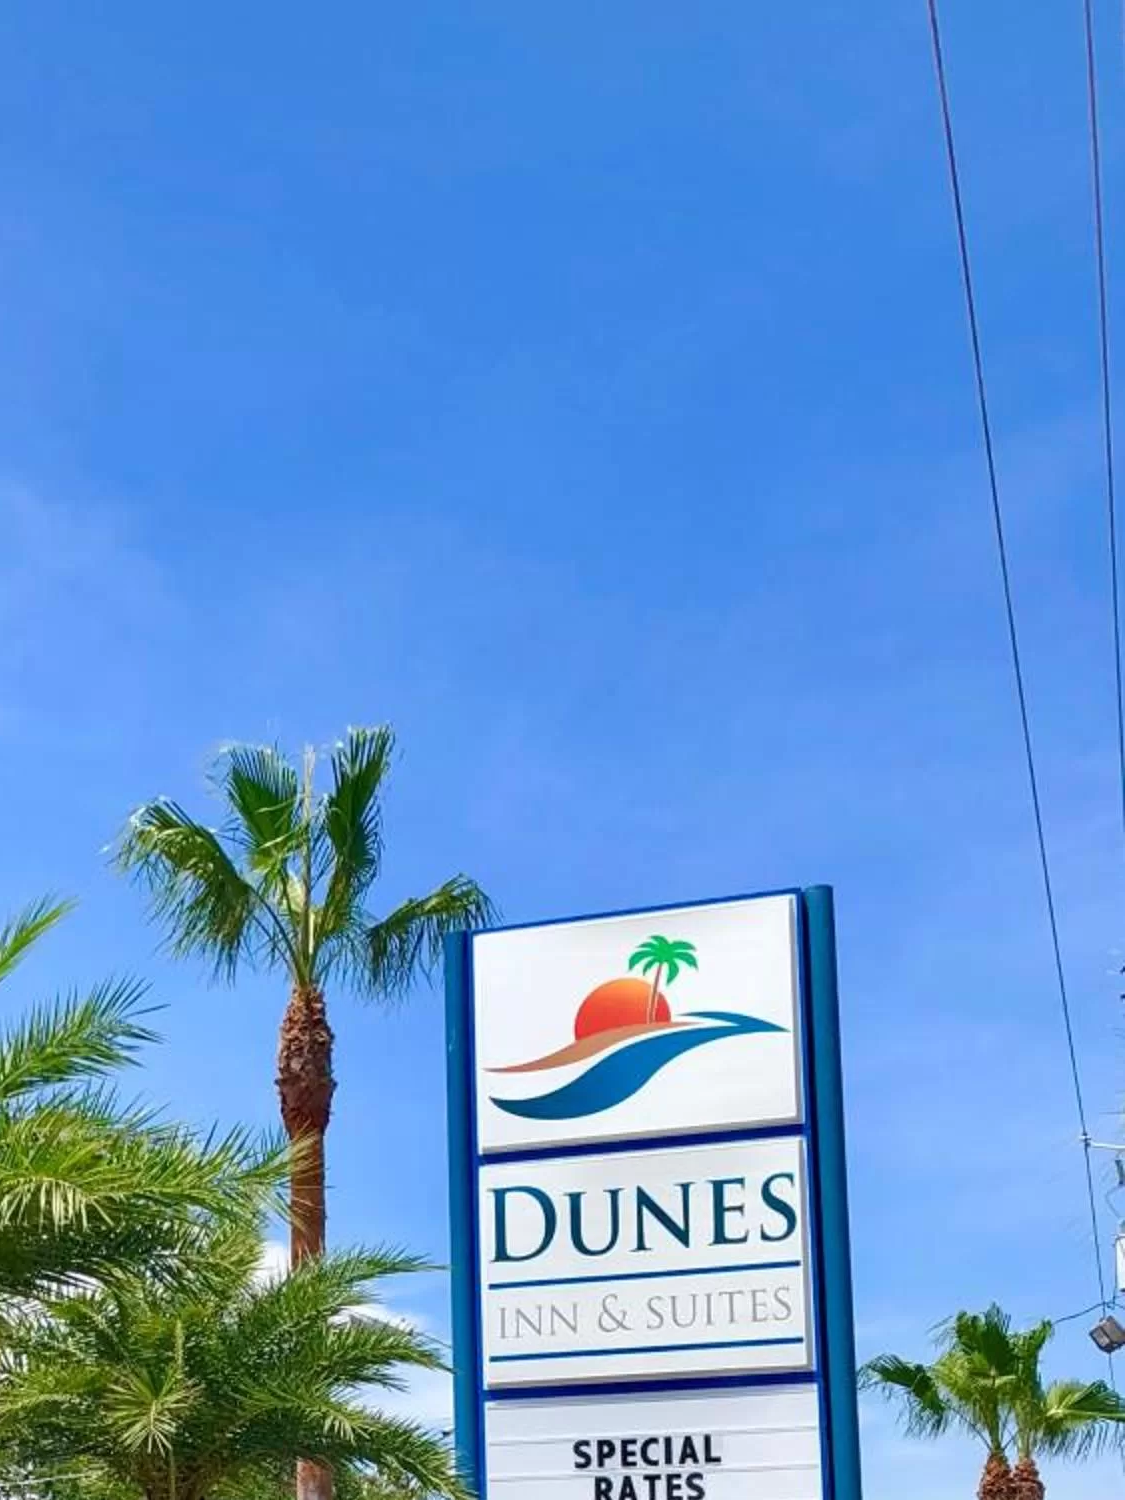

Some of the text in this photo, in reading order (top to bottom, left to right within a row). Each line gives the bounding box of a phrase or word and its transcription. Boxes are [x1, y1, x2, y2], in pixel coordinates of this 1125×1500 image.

[487, 1171, 797, 1263] DUNES
[499, 1285, 793, 1340] INN & SUITES
[573, 1433, 722, 1469] SPECIAL
